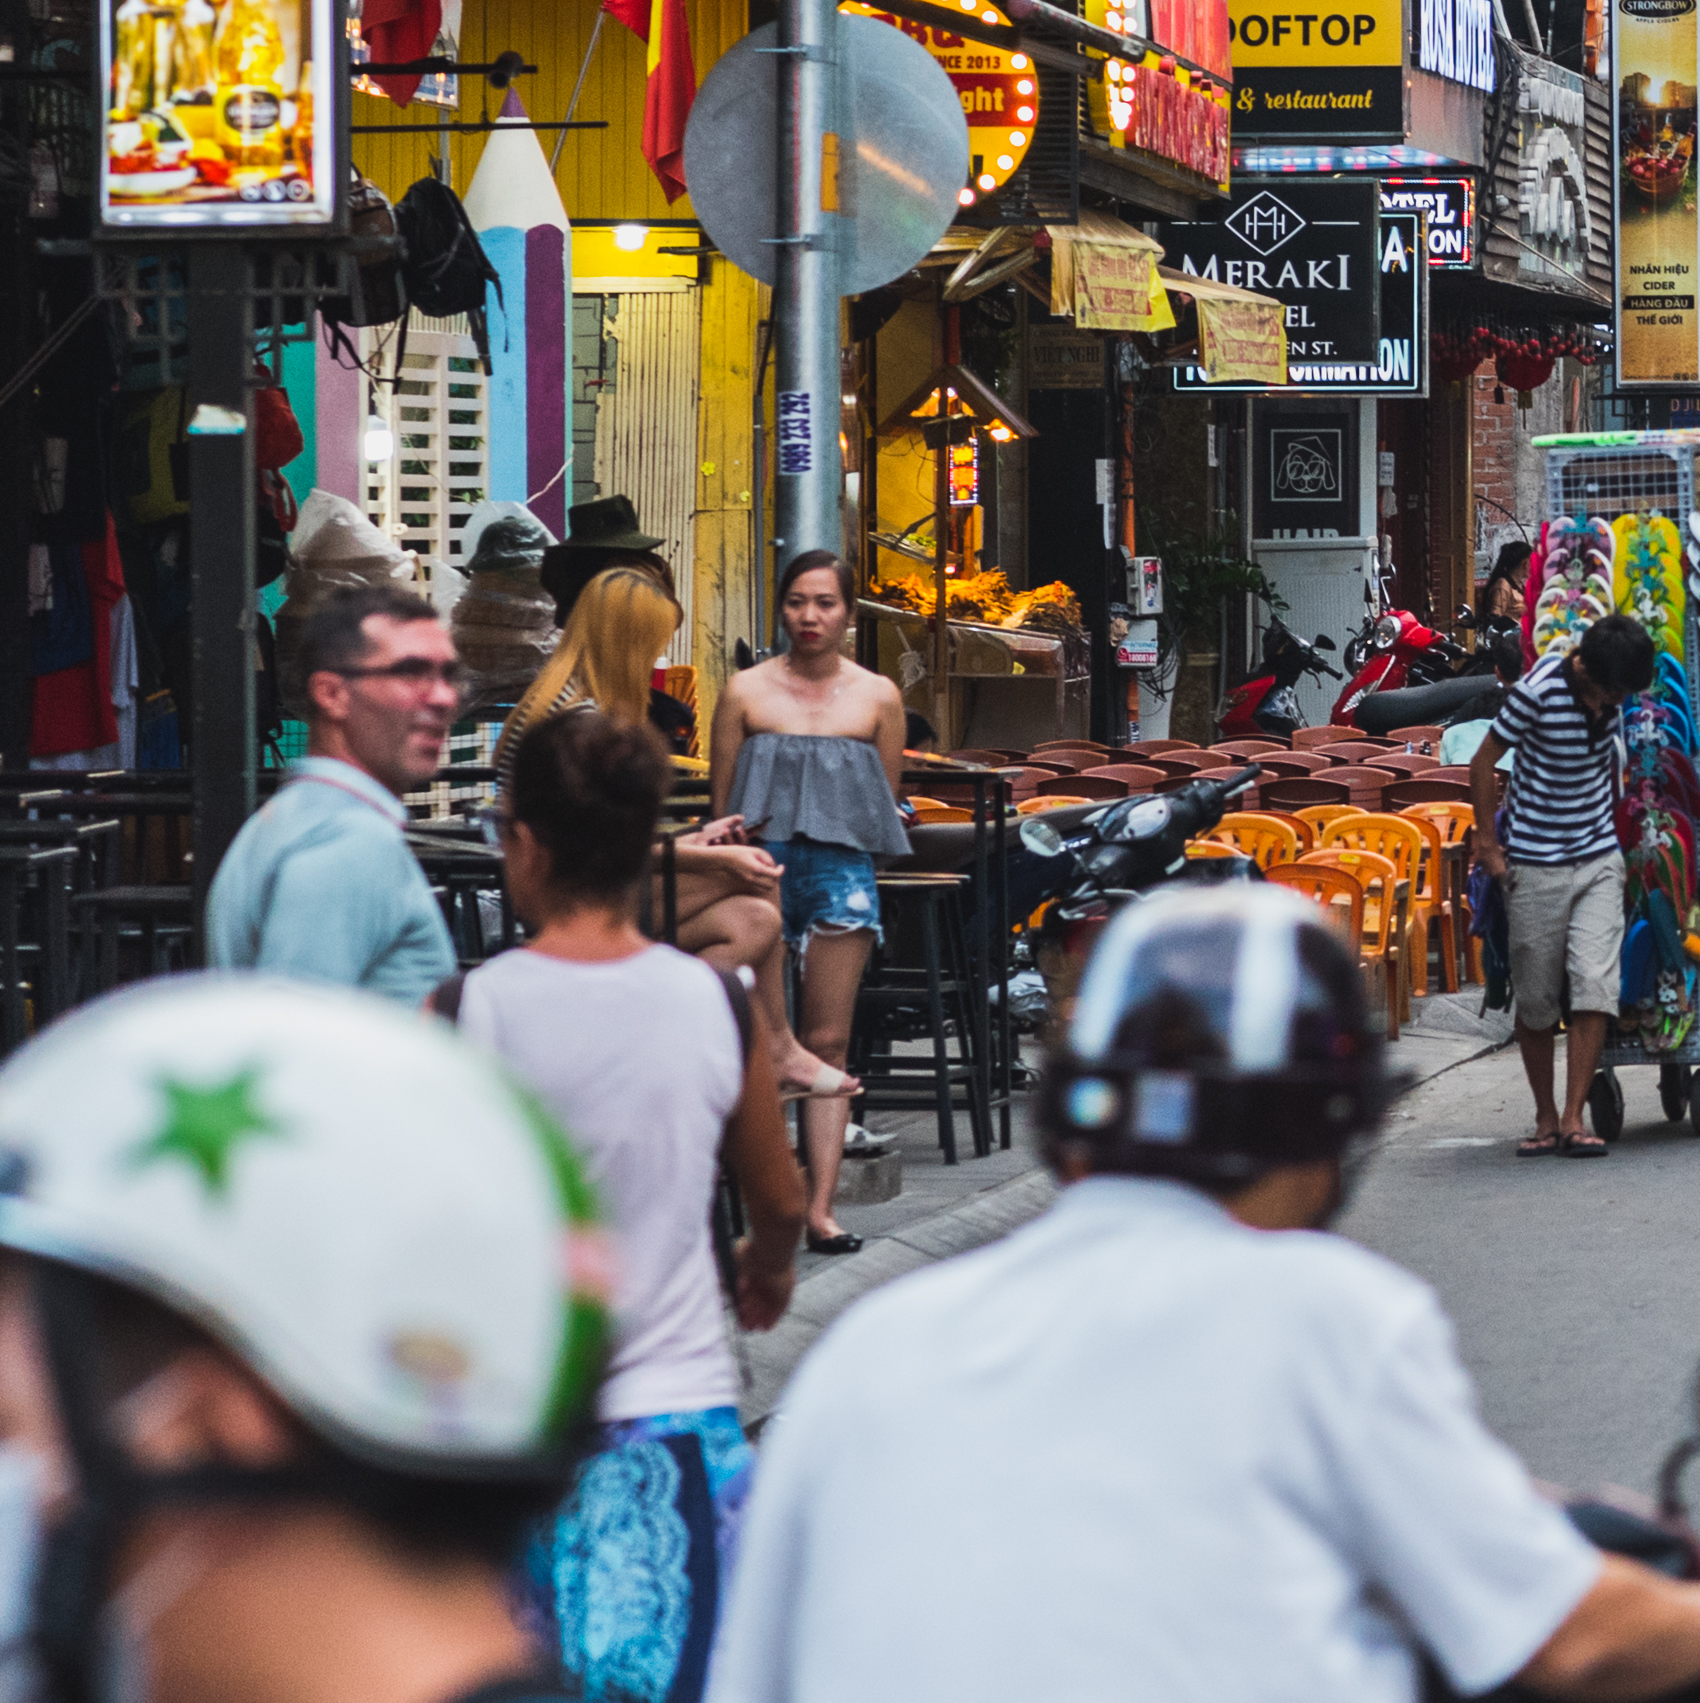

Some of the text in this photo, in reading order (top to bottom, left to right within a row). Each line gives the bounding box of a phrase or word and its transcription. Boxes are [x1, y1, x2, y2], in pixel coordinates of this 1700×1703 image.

[1626, 0, 1689, 11] STRONGBOW
[967, 55, 1001, 69] 2013
[1236, 87, 1373, 113] & restaurant
[1183, 254, 1352, 291] MERAKI
[1643, 281, 1675, 290] CIDER
[1630, 296, 1688, 308] HÀNG ĐẦU
[1635, 313, 1656, 325] THẾ
[1311, 341, 1338, 356] ST.
